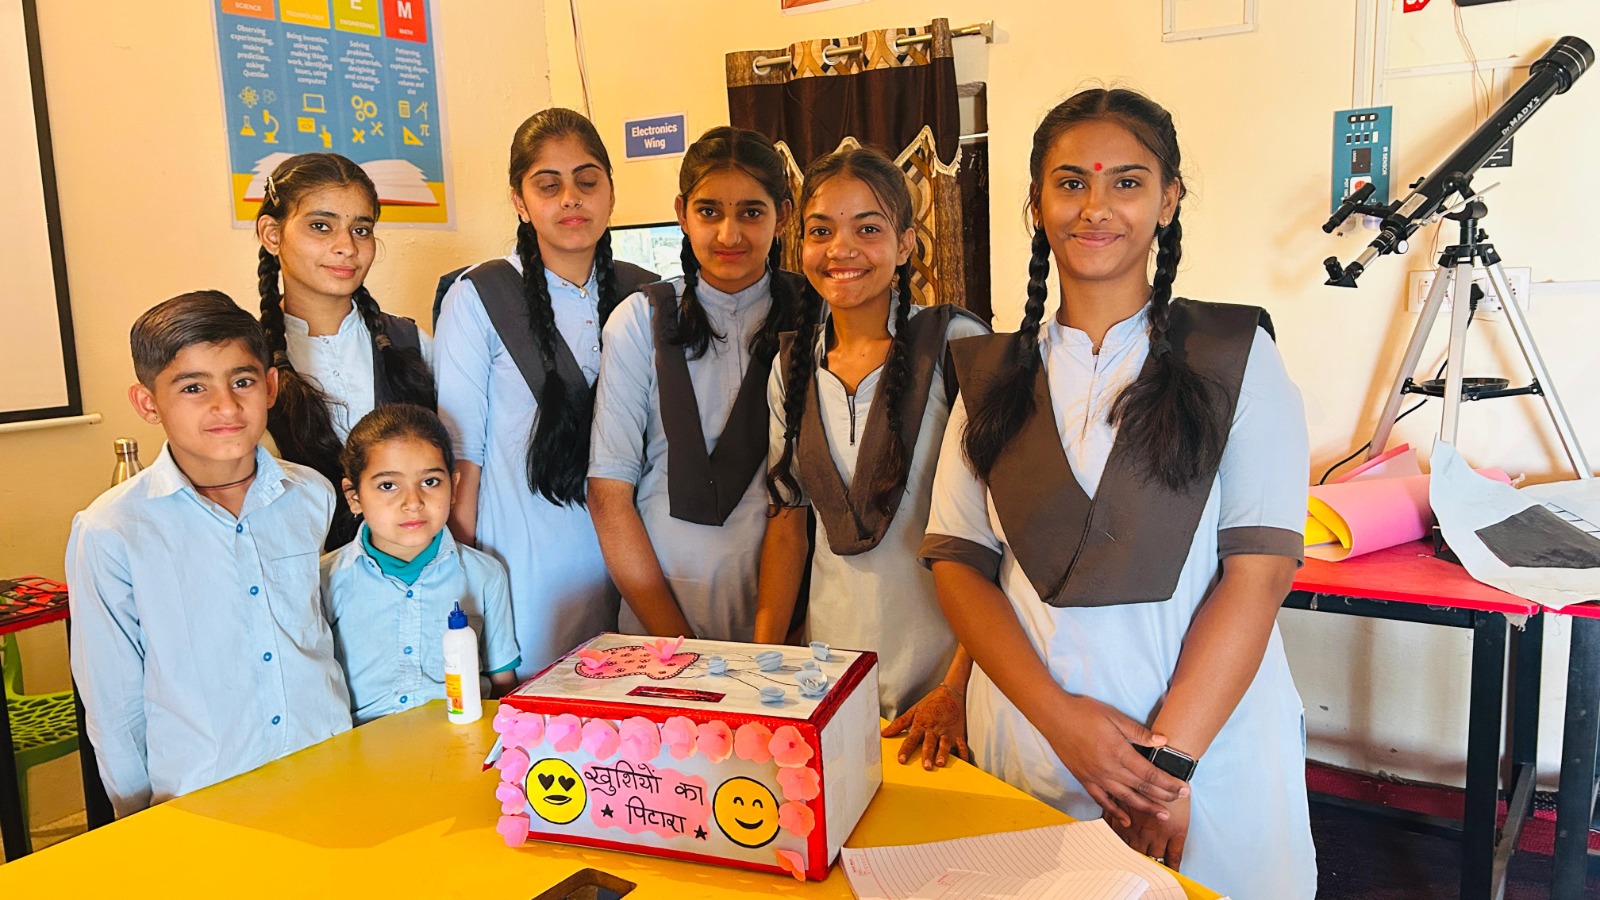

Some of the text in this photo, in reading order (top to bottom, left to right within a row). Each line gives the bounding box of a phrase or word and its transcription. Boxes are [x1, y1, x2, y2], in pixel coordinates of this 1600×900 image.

[235, 2, 262, 12] SCIENCE
[397, 0, 413, 20] M
[285, 10, 325, 21] TECHNOLOGY
[339, 19, 376, 30] ENGINEERING
[236, 24, 266, 37] Observing
[398, 28, 414, 36] MATH
[286, 31, 302, 42] Being
[242, 44, 265, 54] making
[293, 42, 309, 51] using
[349, 40, 370, 51] Solving
[290, 50, 329, 61] making things
[339, 56, 355, 66] using
[246, 61, 265, 71] asking
[242, 69, 270, 78] Question
[313, 69, 328, 79] using
[344, 73, 356, 81] and
[297, 77, 327, 86] computers
[352, 81, 375, 92] building
[631, 122, 678, 138] Electronics
[644, 137, 666, 150] Wing
[584, 760, 704, 806] खुशियों का
[625, 796, 687, 833] पिटारा
